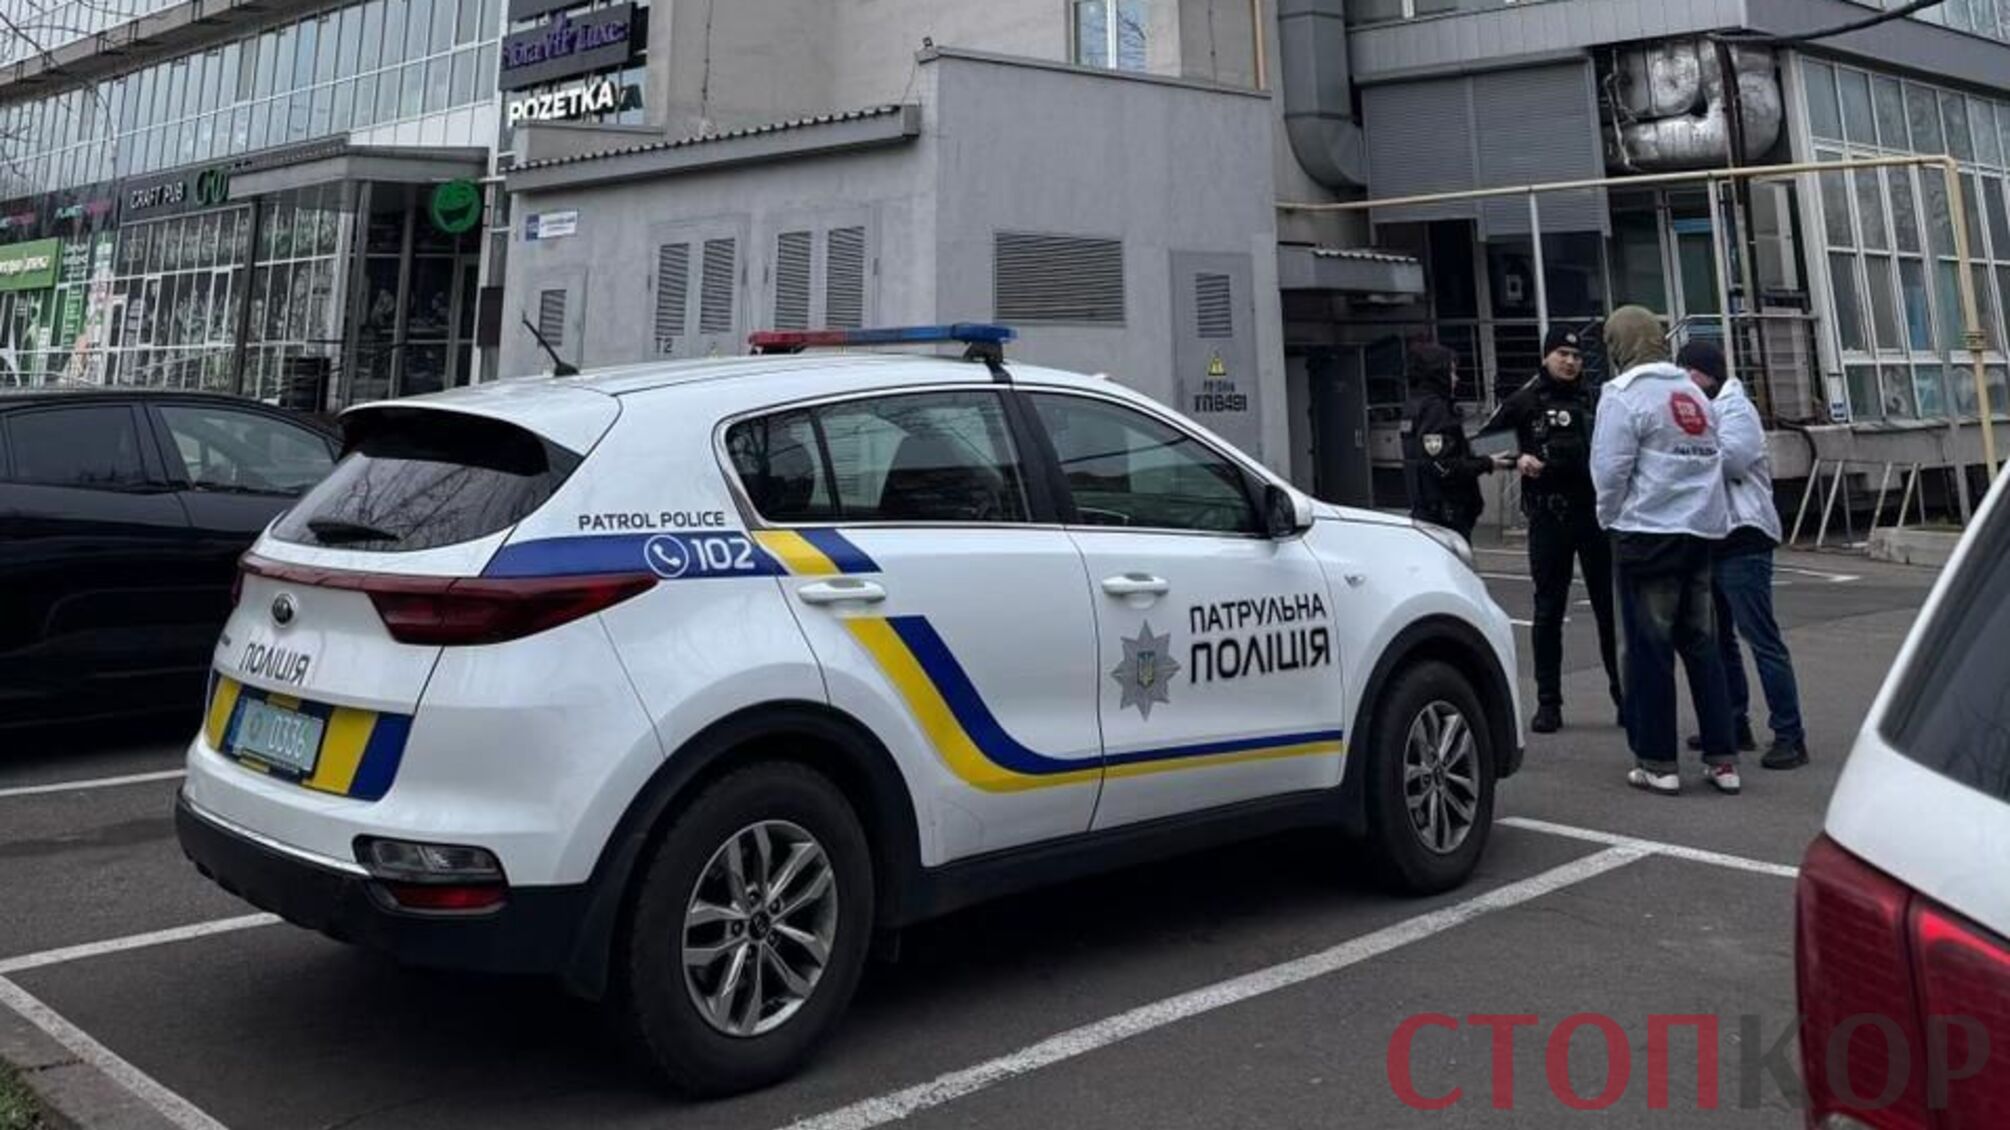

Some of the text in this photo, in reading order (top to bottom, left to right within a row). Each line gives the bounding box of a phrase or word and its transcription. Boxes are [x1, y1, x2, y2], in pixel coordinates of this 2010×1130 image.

[578, 511, 725, 530] PATROL POLICE
[690, 538, 755, 571] 102
[1189, 592, 1327, 634] ПАТРУЛЬНА
[239, 643, 310, 686] ПОЛІЦІЯ
[1190, 626, 1331, 684] ПОЛІЦІЯ
